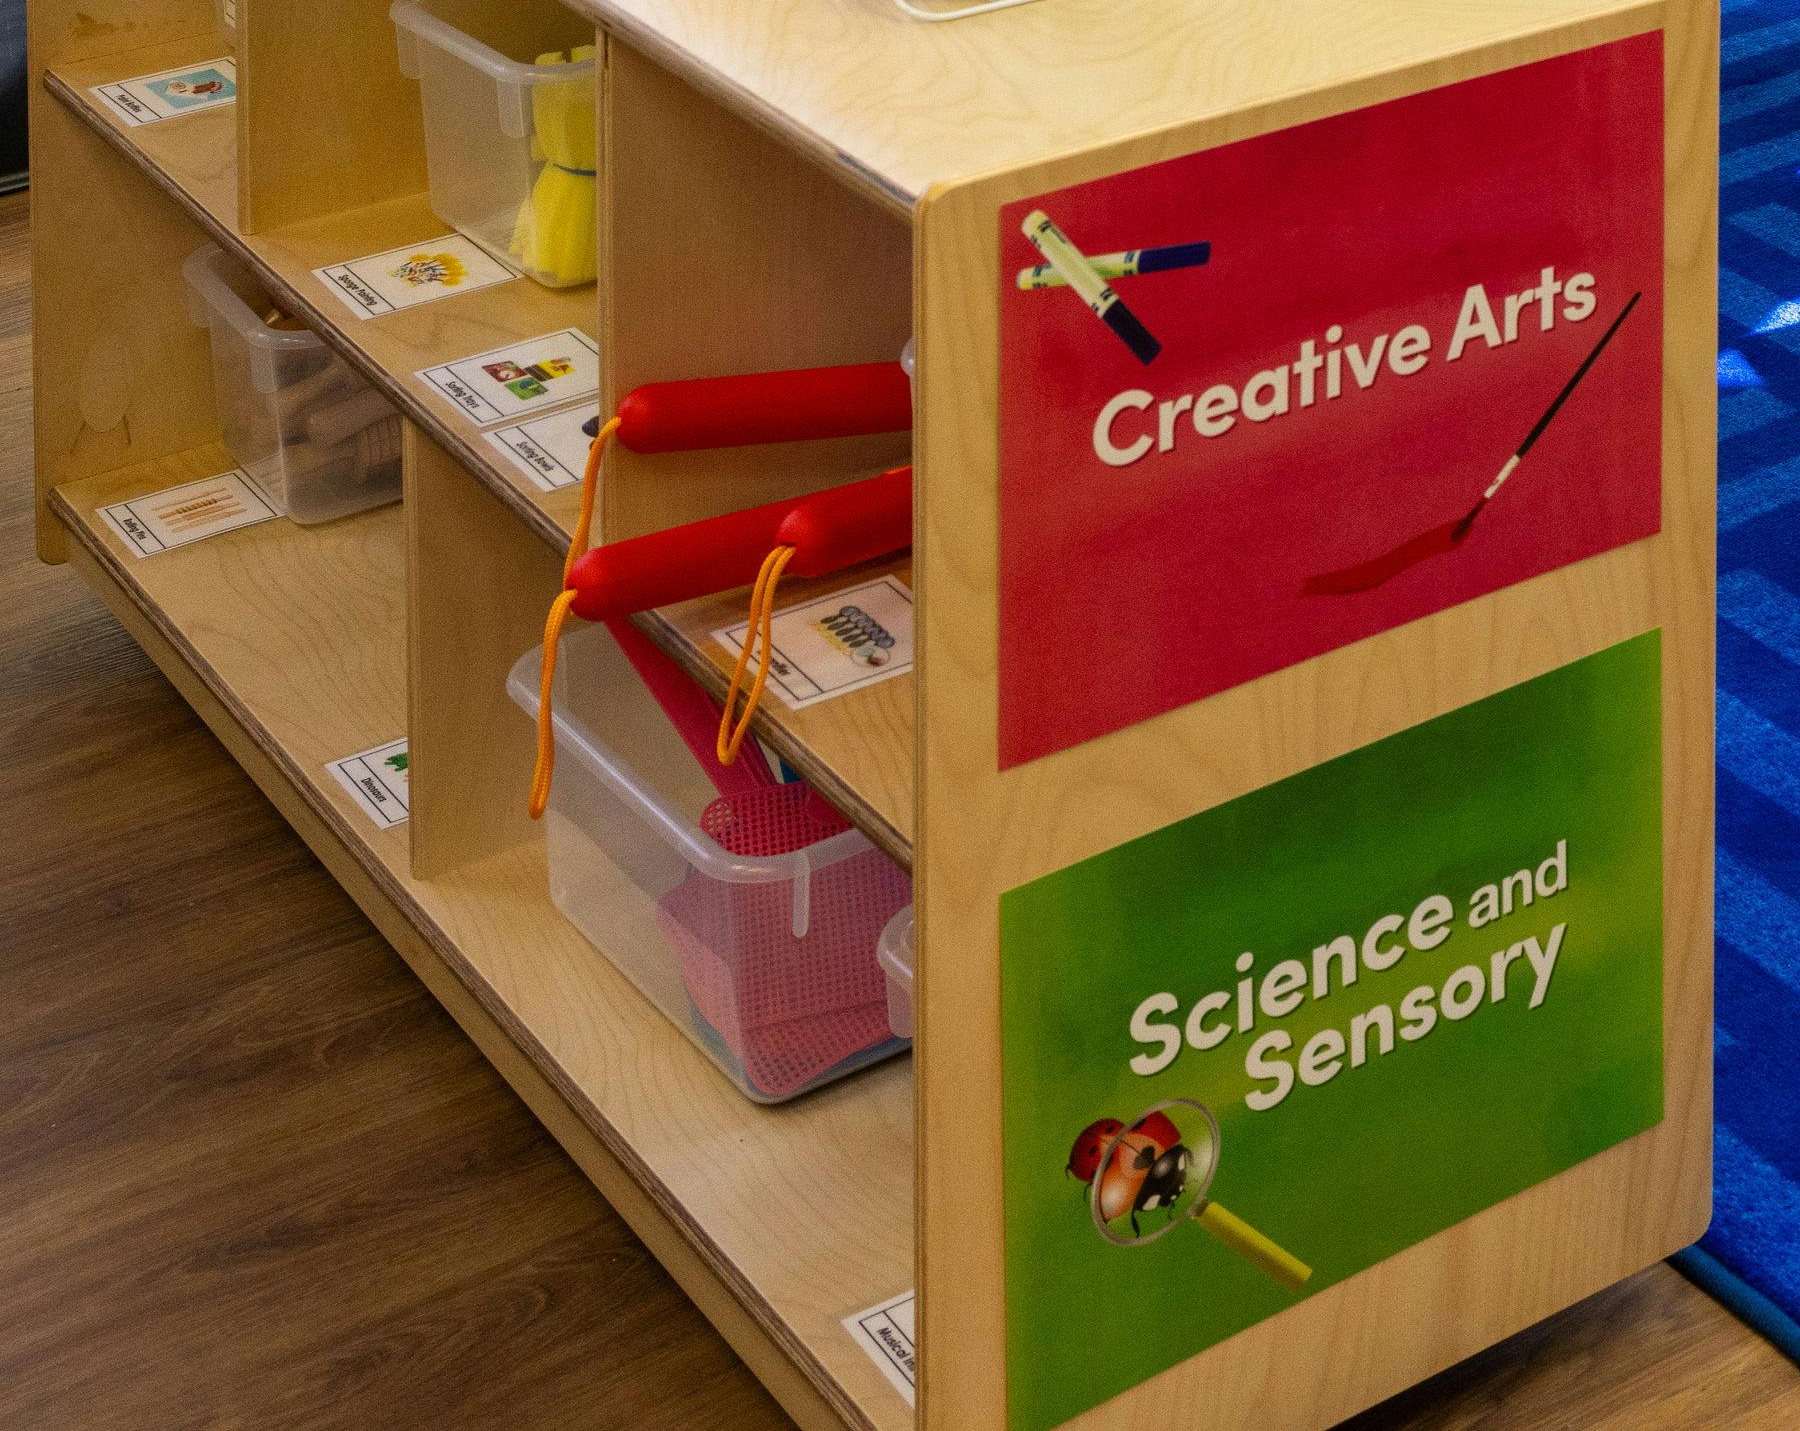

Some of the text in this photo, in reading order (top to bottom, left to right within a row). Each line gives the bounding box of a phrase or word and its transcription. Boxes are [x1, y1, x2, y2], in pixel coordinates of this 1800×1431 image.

[445, 381, 467, 398] Sorting
[1092, 266, 1598, 468] Creative Arts
[361, 777, 387, 803] Dinosaurs
[1129, 839, 1569, 1077] Science and
[1244, 922, 1568, 1113] Sensory
[877, 1327, 911, 1359] Musical
